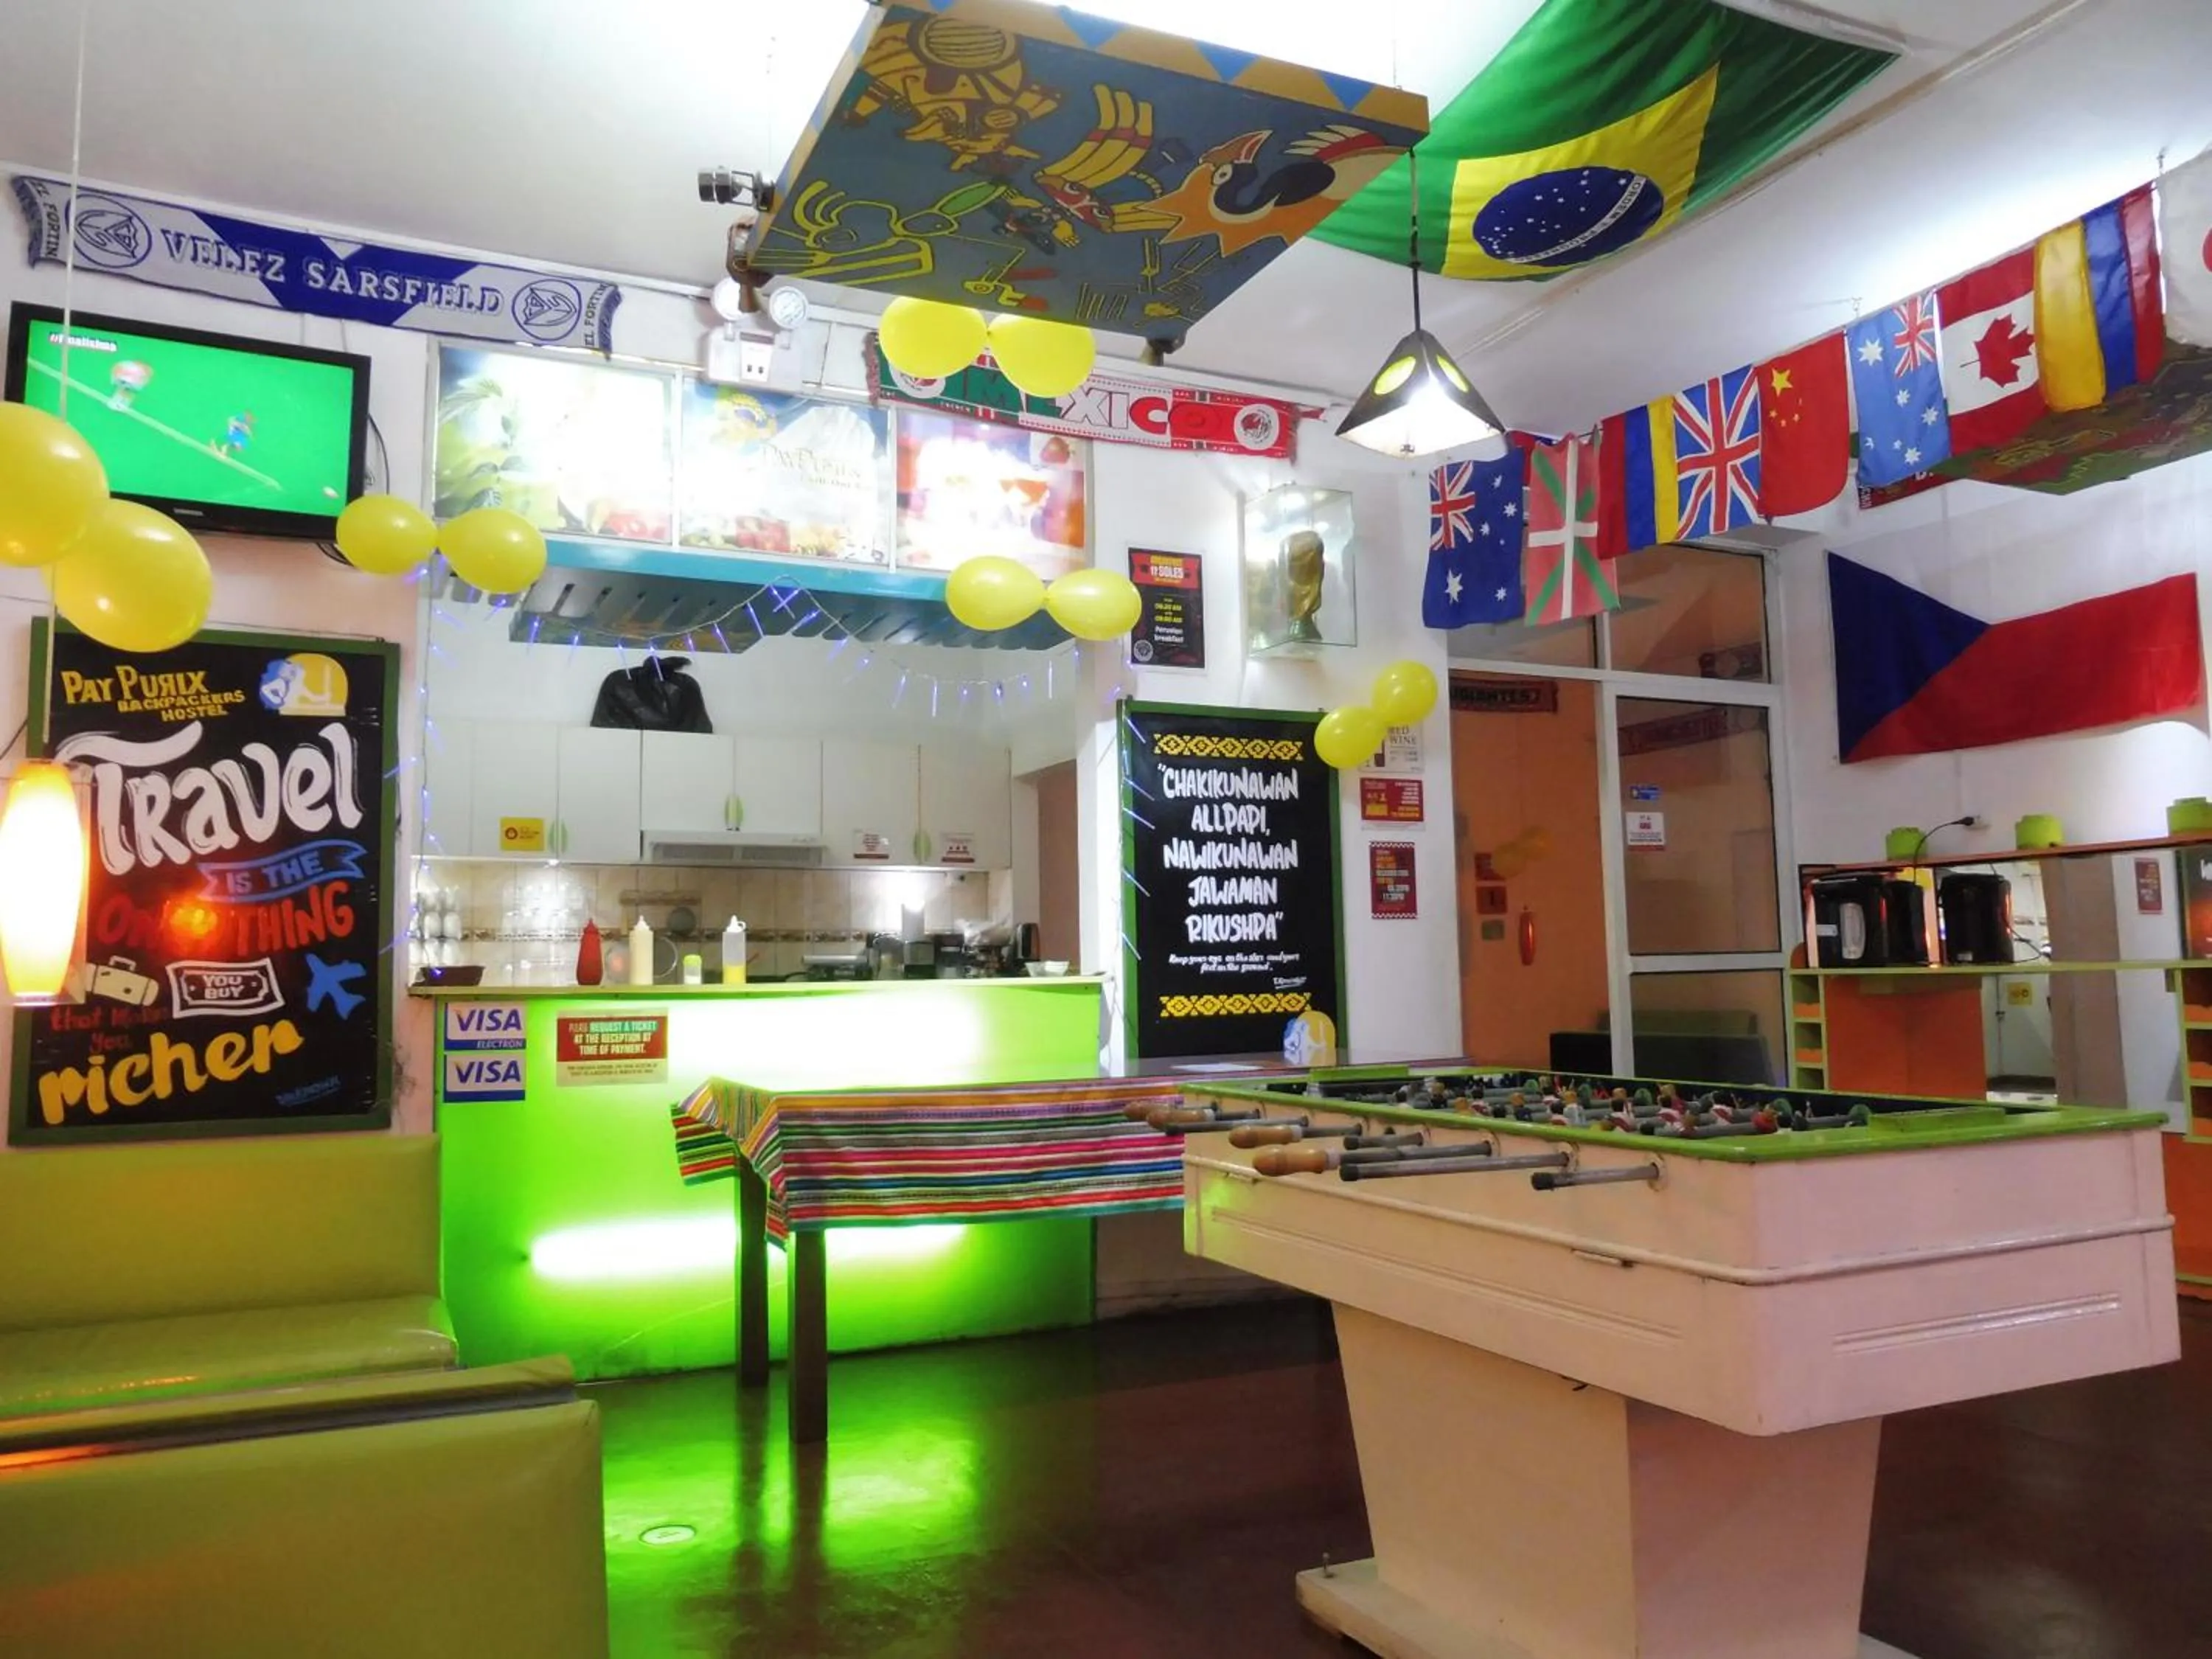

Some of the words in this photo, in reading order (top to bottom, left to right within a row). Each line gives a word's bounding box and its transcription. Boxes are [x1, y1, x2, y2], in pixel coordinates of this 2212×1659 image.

[160, 228, 287, 282] VELEZ
[304, 259, 505, 317] SARSFIELD
[585, 327, 595, 347] EL
[61, 670, 114, 704] PAY
[117, 689, 246, 713] BACKPACKERS
[161, 703, 229, 722] HOSTEL
[1191, 801, 1270, 837] ALLPAPI,
[1163, 837, 1298, 871] NAWIKUNAWAN
[226, 872, 252, 894] IS
[262, 851, 324, 888] THE
[1188, 875, 1278, 908] JAWAMAN
[230, 881, 355, 956] THING
[1185, 911, 1284, 944] RIKUSHPA"
[201, 973, 243, 987] YOU
[204, 985, 244, 1000] BUY
[455, 1009, 523, 1032] VISA
[476, 1039, 524, 1049] ELECTRON
[585, 1033, 600, 1044] THE
[599, 1044, 608, 1055] OF
[38, 1019, 306, 1124] richer
[455, 1060, 522, 1085] VISA
